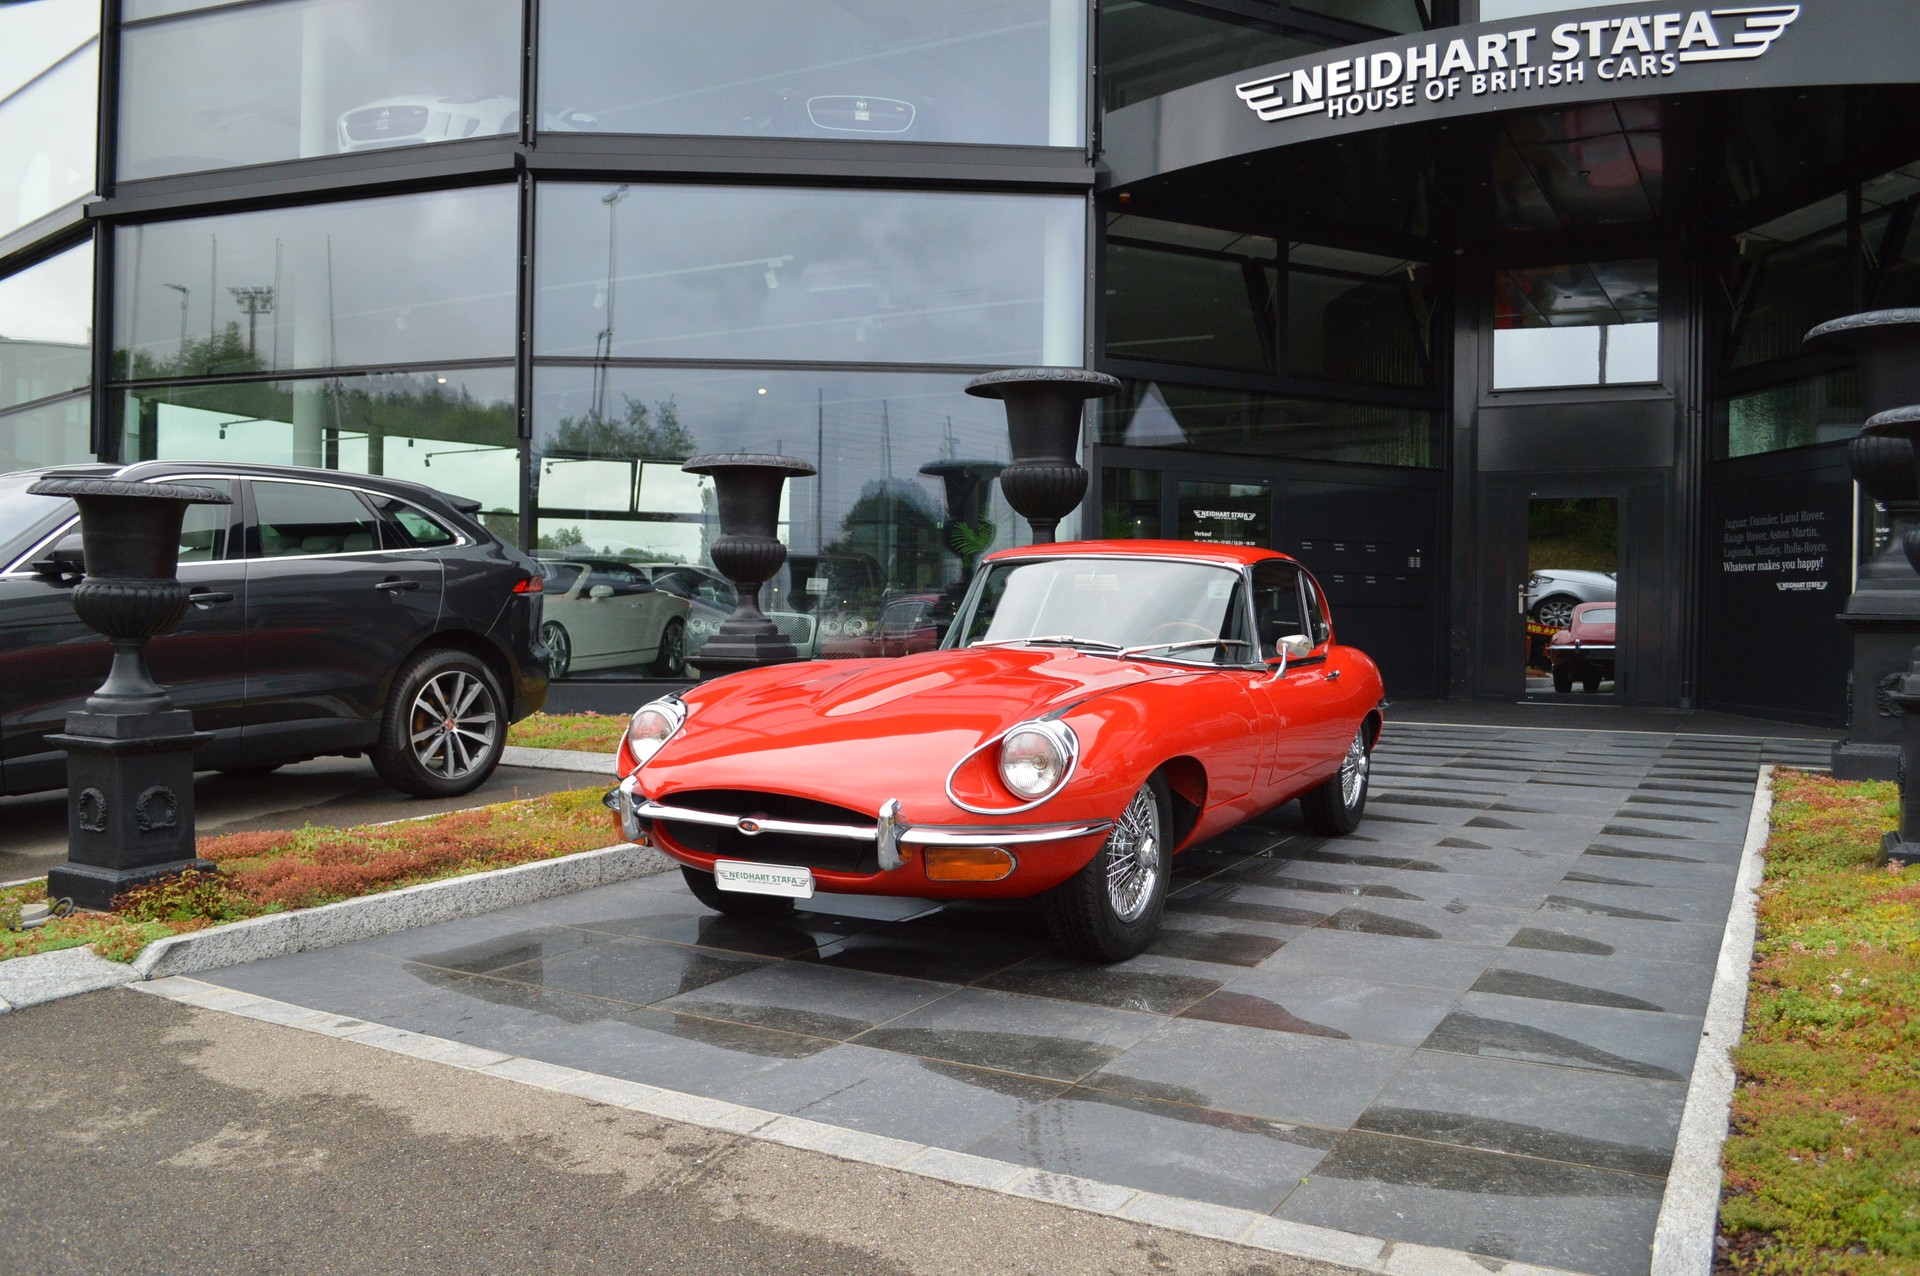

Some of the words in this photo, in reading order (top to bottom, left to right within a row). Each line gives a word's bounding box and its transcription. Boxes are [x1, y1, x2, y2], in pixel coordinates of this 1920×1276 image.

[1292, 28, 1536, 104] NEIDHART
[1551, 11, 1720, 62] STÄFA
[1328, 84, 1414, 119] HOUSE
[1425, 77, 1460, 101] OF
[1472, 61, 1584, 95] BRITISH
[1597, 53, 1677, 81] CARS
[1780, 511, 1799, 524] Land
[1724, 533, 1745, 545] Range
[1768, 529, 1790, 540] Aston
[1723, 561, 1756, 572] Whatever
[1757, 559, 1780, 571] makes
[1781, 561, 1796, 573] you
[1797, 556, 1824, 572] happy!
[729, 871, 769, 881] NEIDHART
